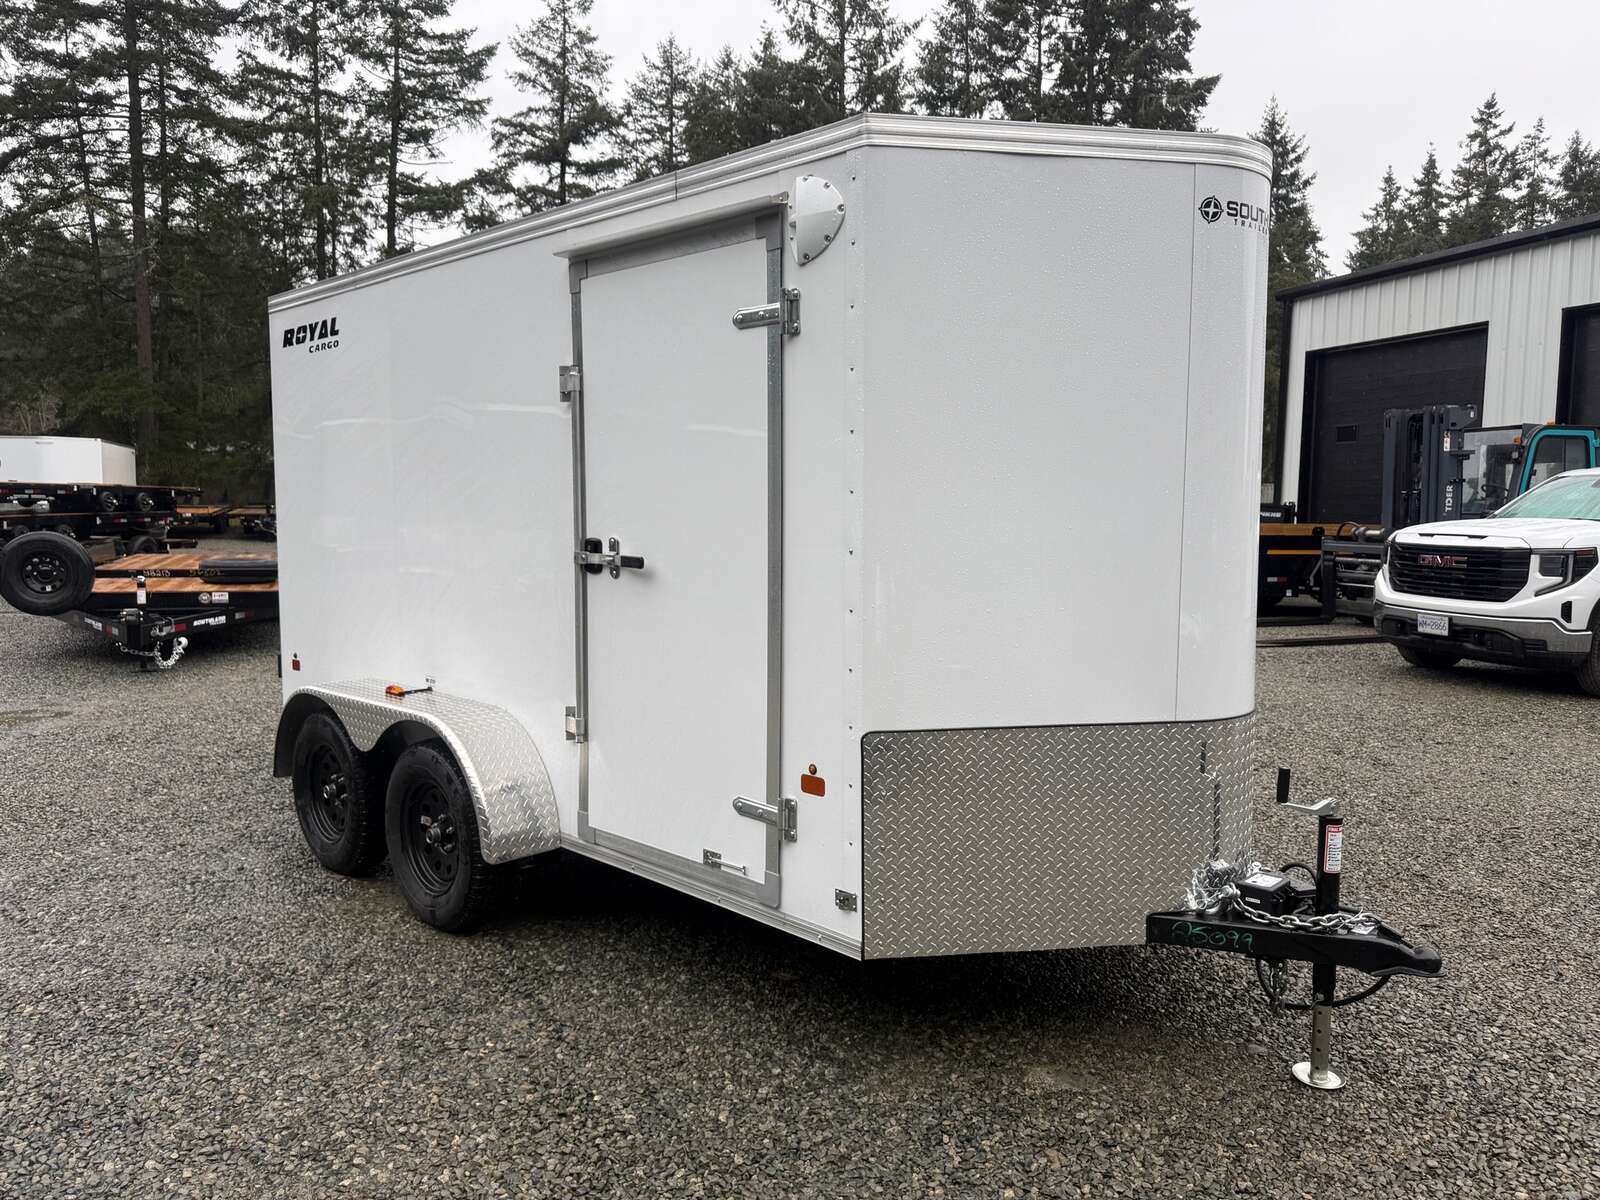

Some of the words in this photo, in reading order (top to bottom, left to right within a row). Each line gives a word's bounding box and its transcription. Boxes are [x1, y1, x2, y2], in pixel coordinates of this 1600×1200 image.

[282, 317, 340, 348] ROYAL
[308, 339, 340, 354] CARGO
[1417, 554, 1468, 568] GMC
